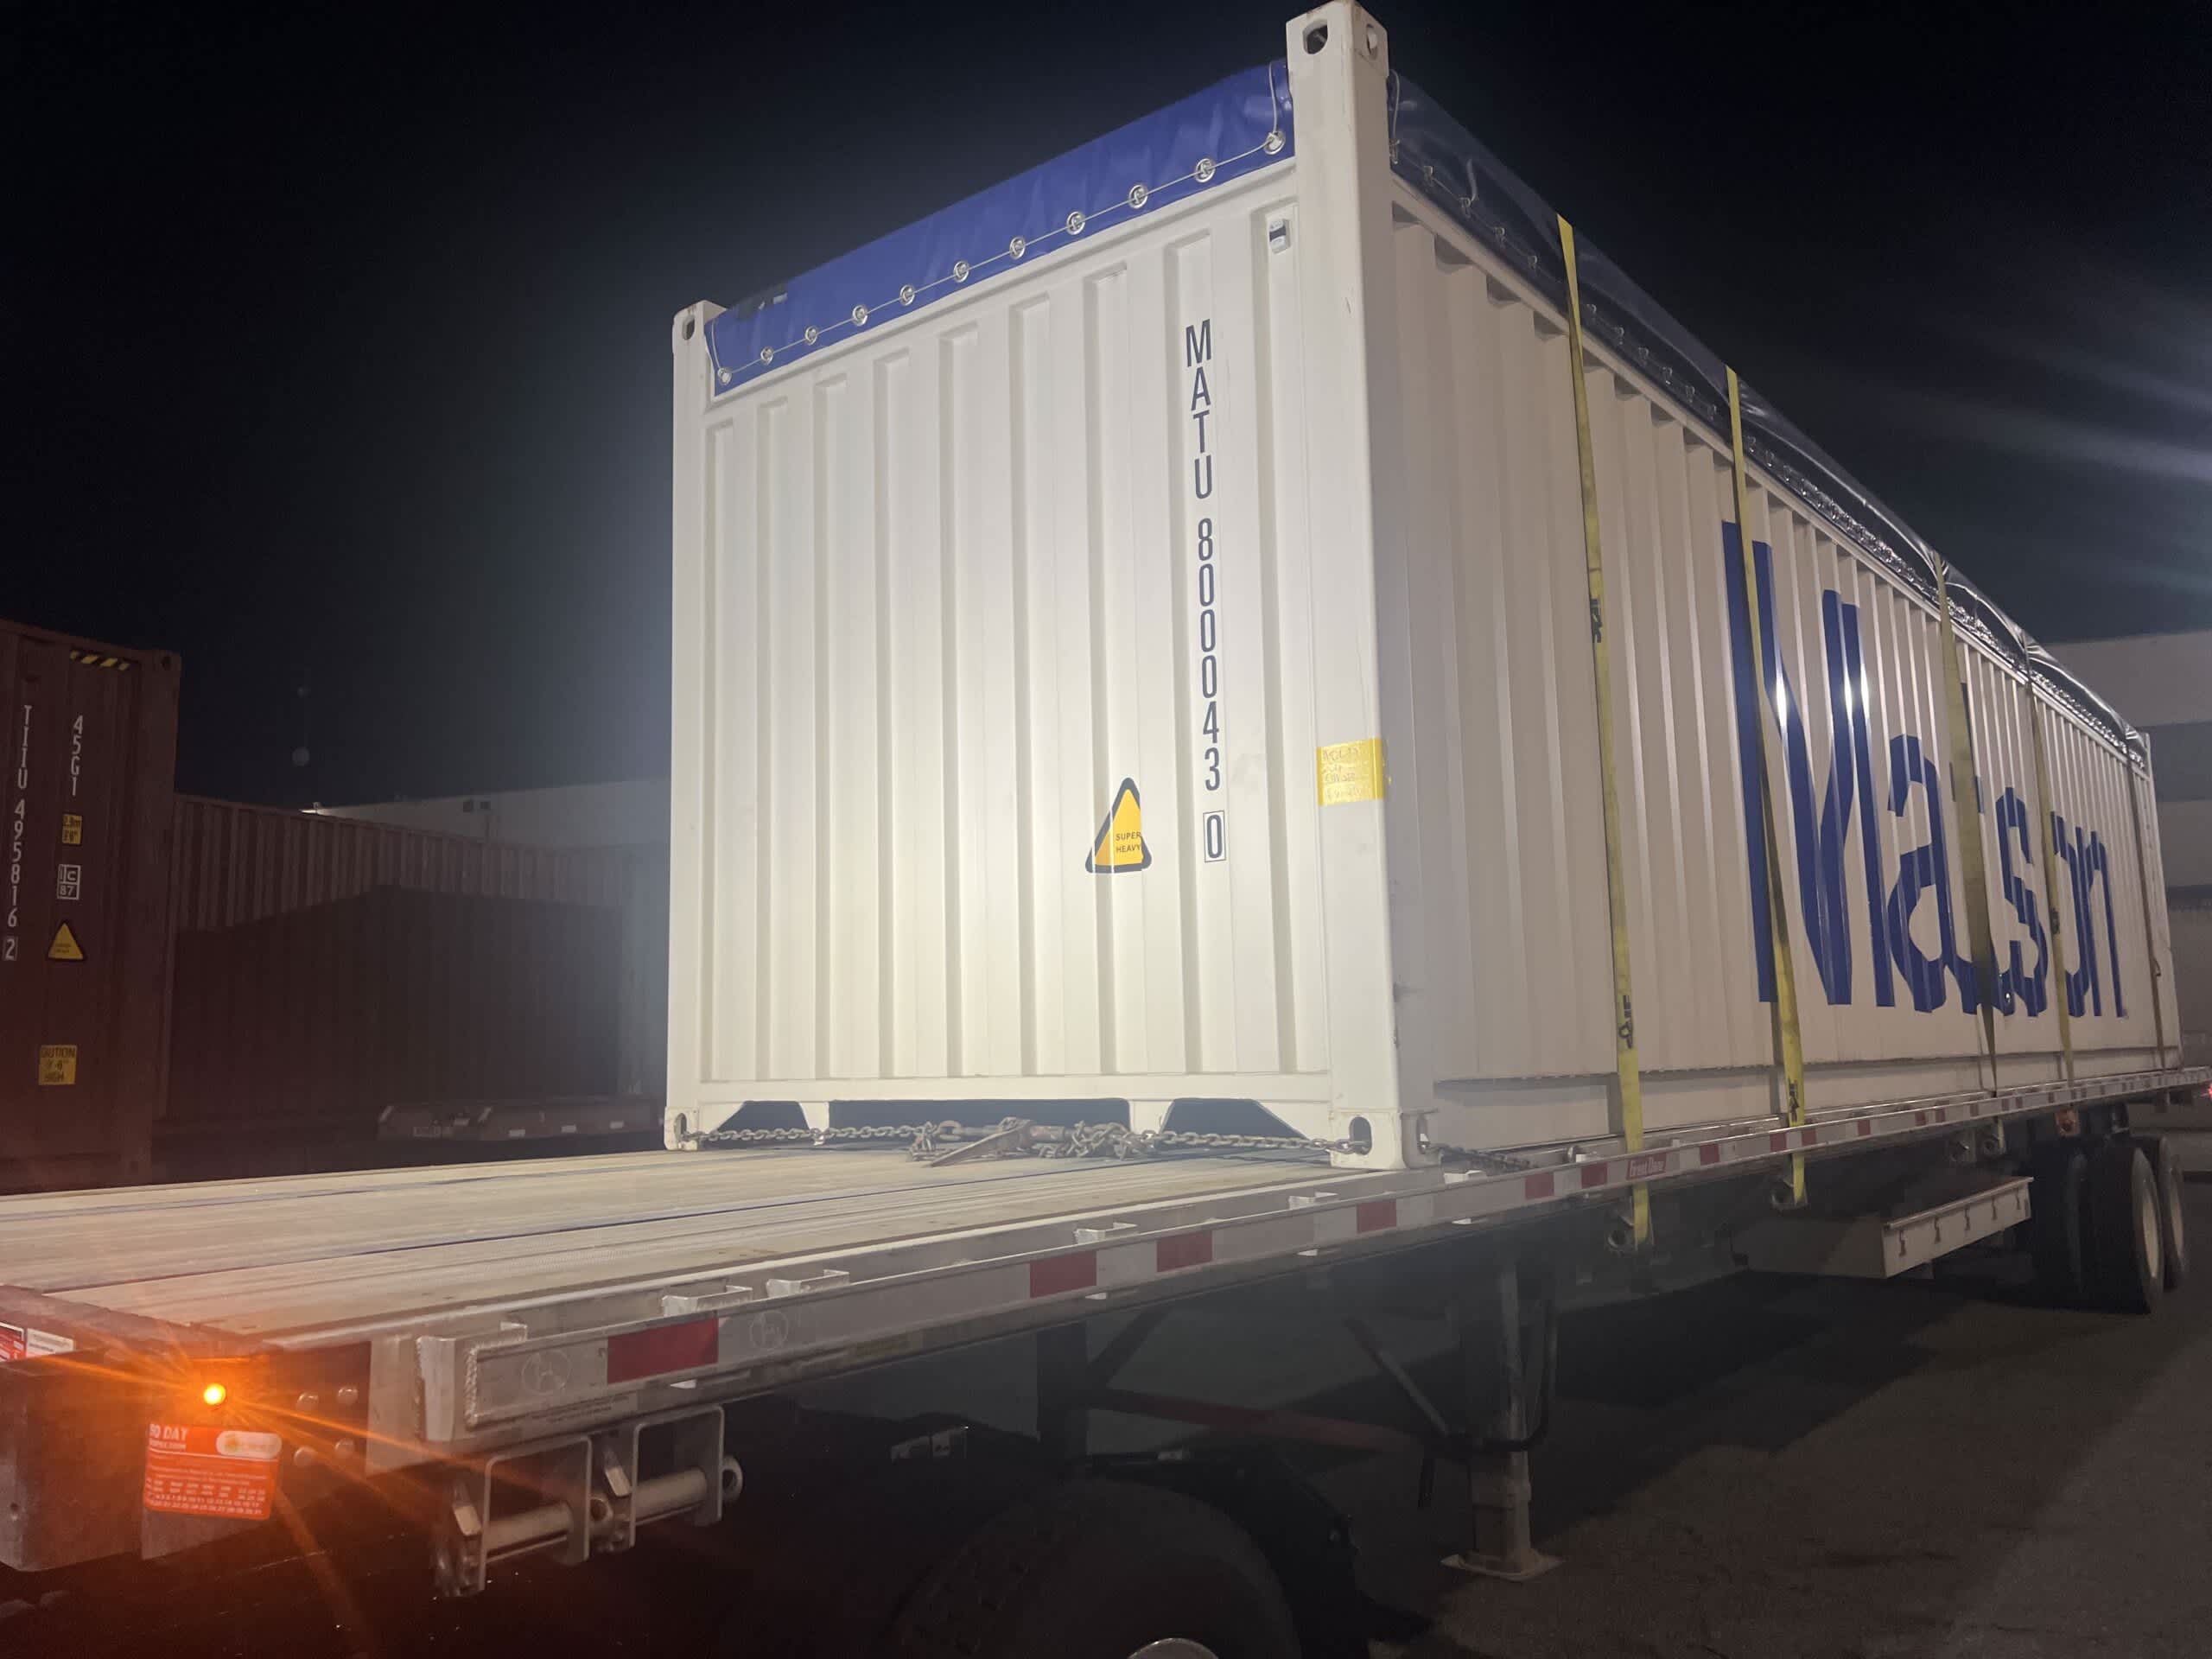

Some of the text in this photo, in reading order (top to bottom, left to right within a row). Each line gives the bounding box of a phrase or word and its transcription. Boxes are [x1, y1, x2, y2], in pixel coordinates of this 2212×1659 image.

[1185, 319, 1224, 859] MATU 800043 0
[71, 715, 83, 796] 45G1
[1116, 831, 1141, 842] SUPER
[1116, 843, 1141, 854] HEAVY
[8, 798, 25, 927] 495816
[5, 938, 16, 960] 2
[162, 1425, 188, 1441] DAY
